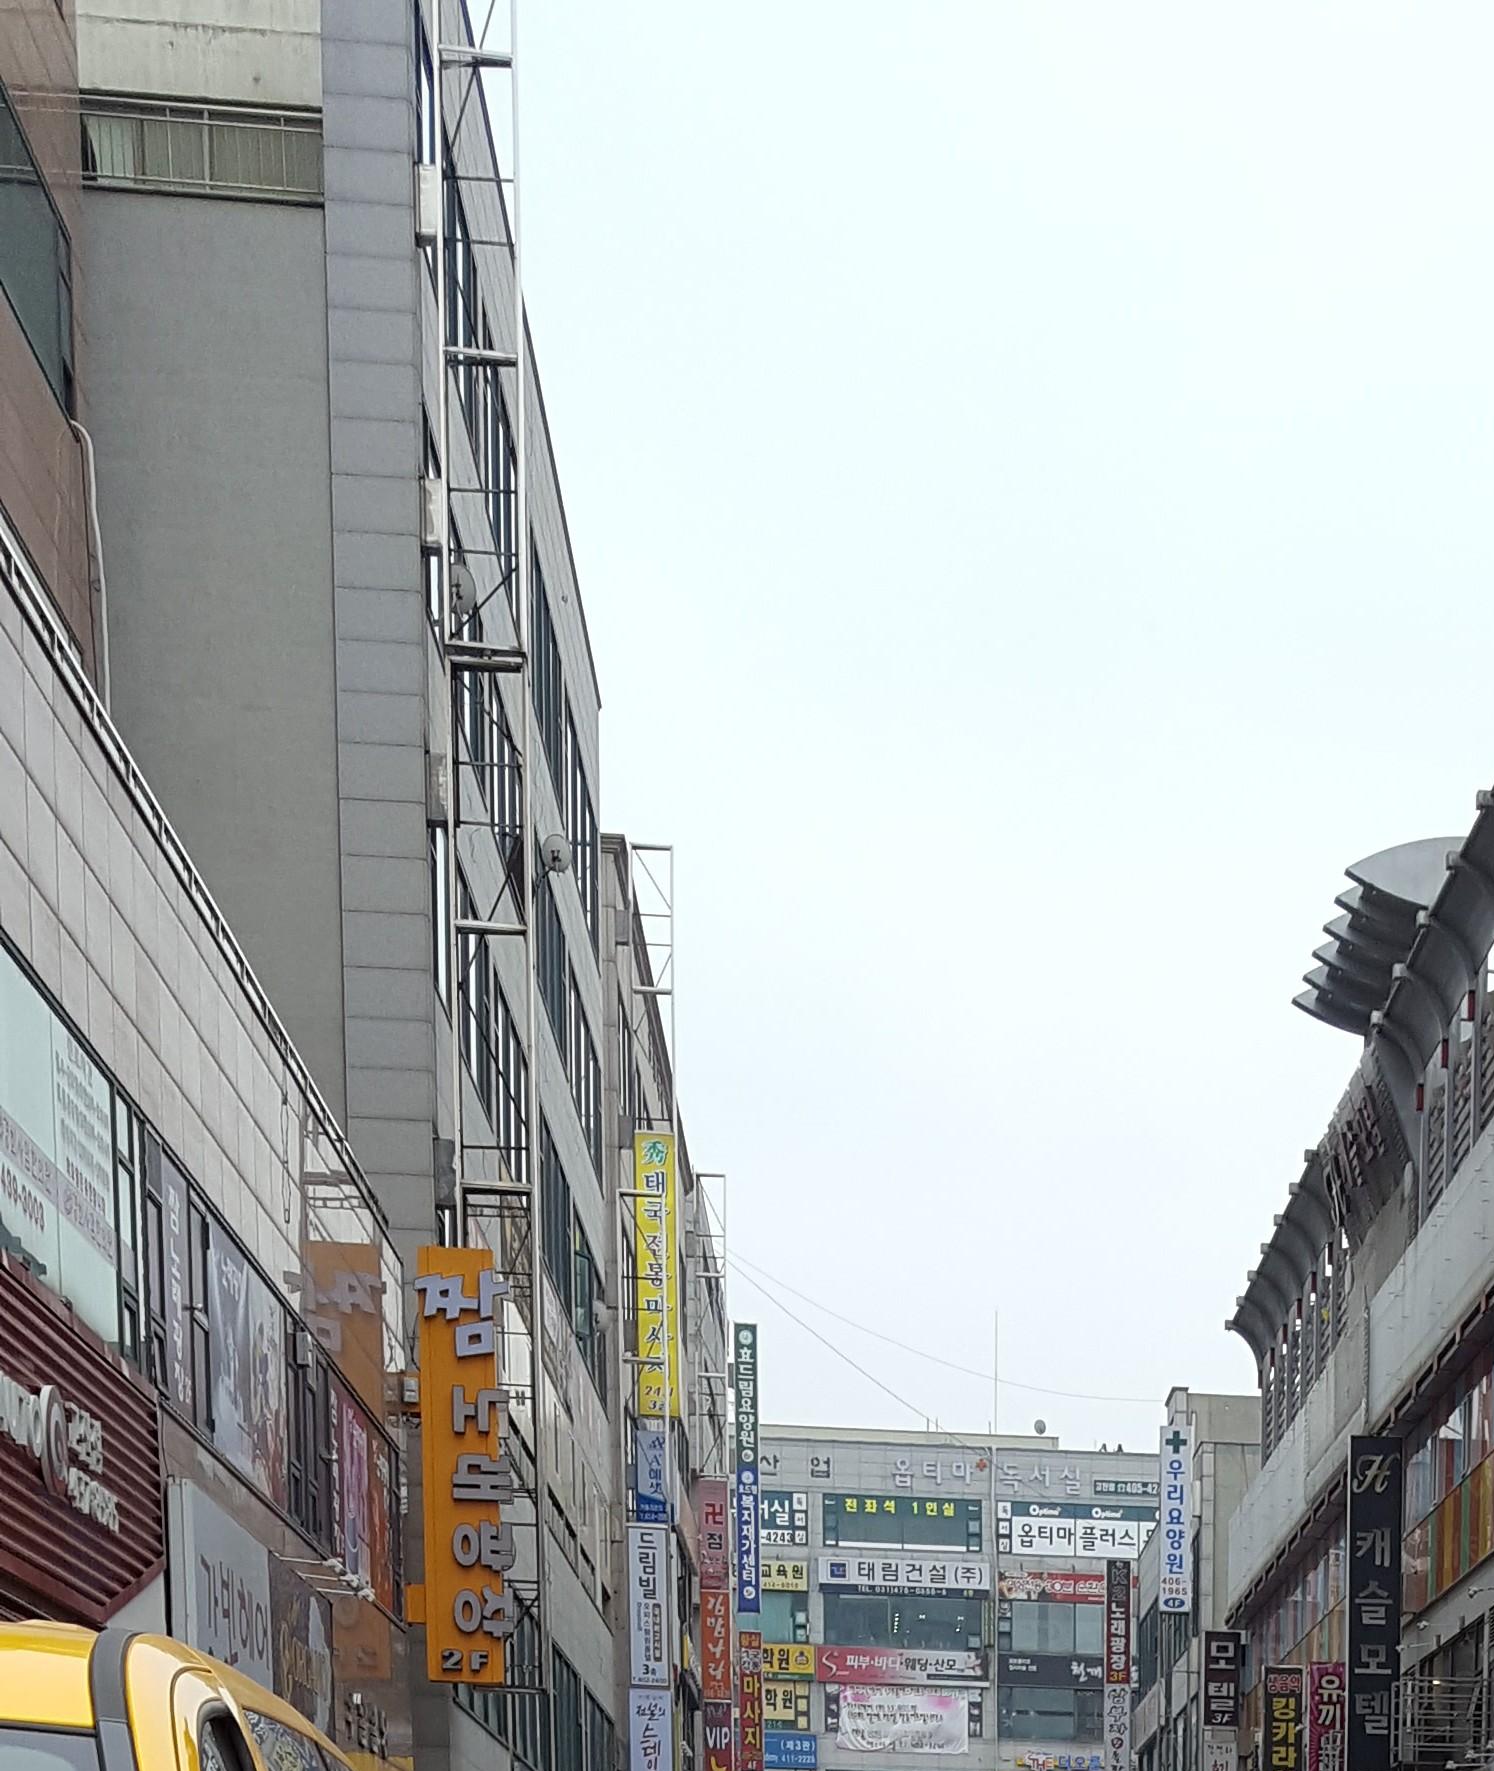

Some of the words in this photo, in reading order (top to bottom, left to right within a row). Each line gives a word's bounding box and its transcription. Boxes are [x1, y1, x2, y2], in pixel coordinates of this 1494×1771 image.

[893, 1456, 974, 1488] 옵티마
[999, 1463, 1082, 1496] 독서실
[450, 1382, 515, 1638] 노래광장
[845, 1497, 897, 1513] 전좌석
[1166, 1459, 1186, 1576] 우리요양원
[1017, 1523, 1074, 1546] 옵티마
[1079, 1525, 1137, 1551] 플러스
[638, 1531, 658, 1600] 드림빌
[856, 1561, 948, 1584] 태림건설
[953, 1564, 984, 1584] (주)
[1354, 1527, 1393, 1737] 캐슬모텔
[762, 1647, 790, 1671] 학원
[1109, 1671, 1127, 1681] 3F
[1207, 1640, 1236, 1712] 모텔
[743, 1674, 761, 1750] 마사지
[764, 1688, 793, 1712] 학원
[1210, 1713, 1234, 1725] 3F
[705, 1725, 730, 1750] VIP
